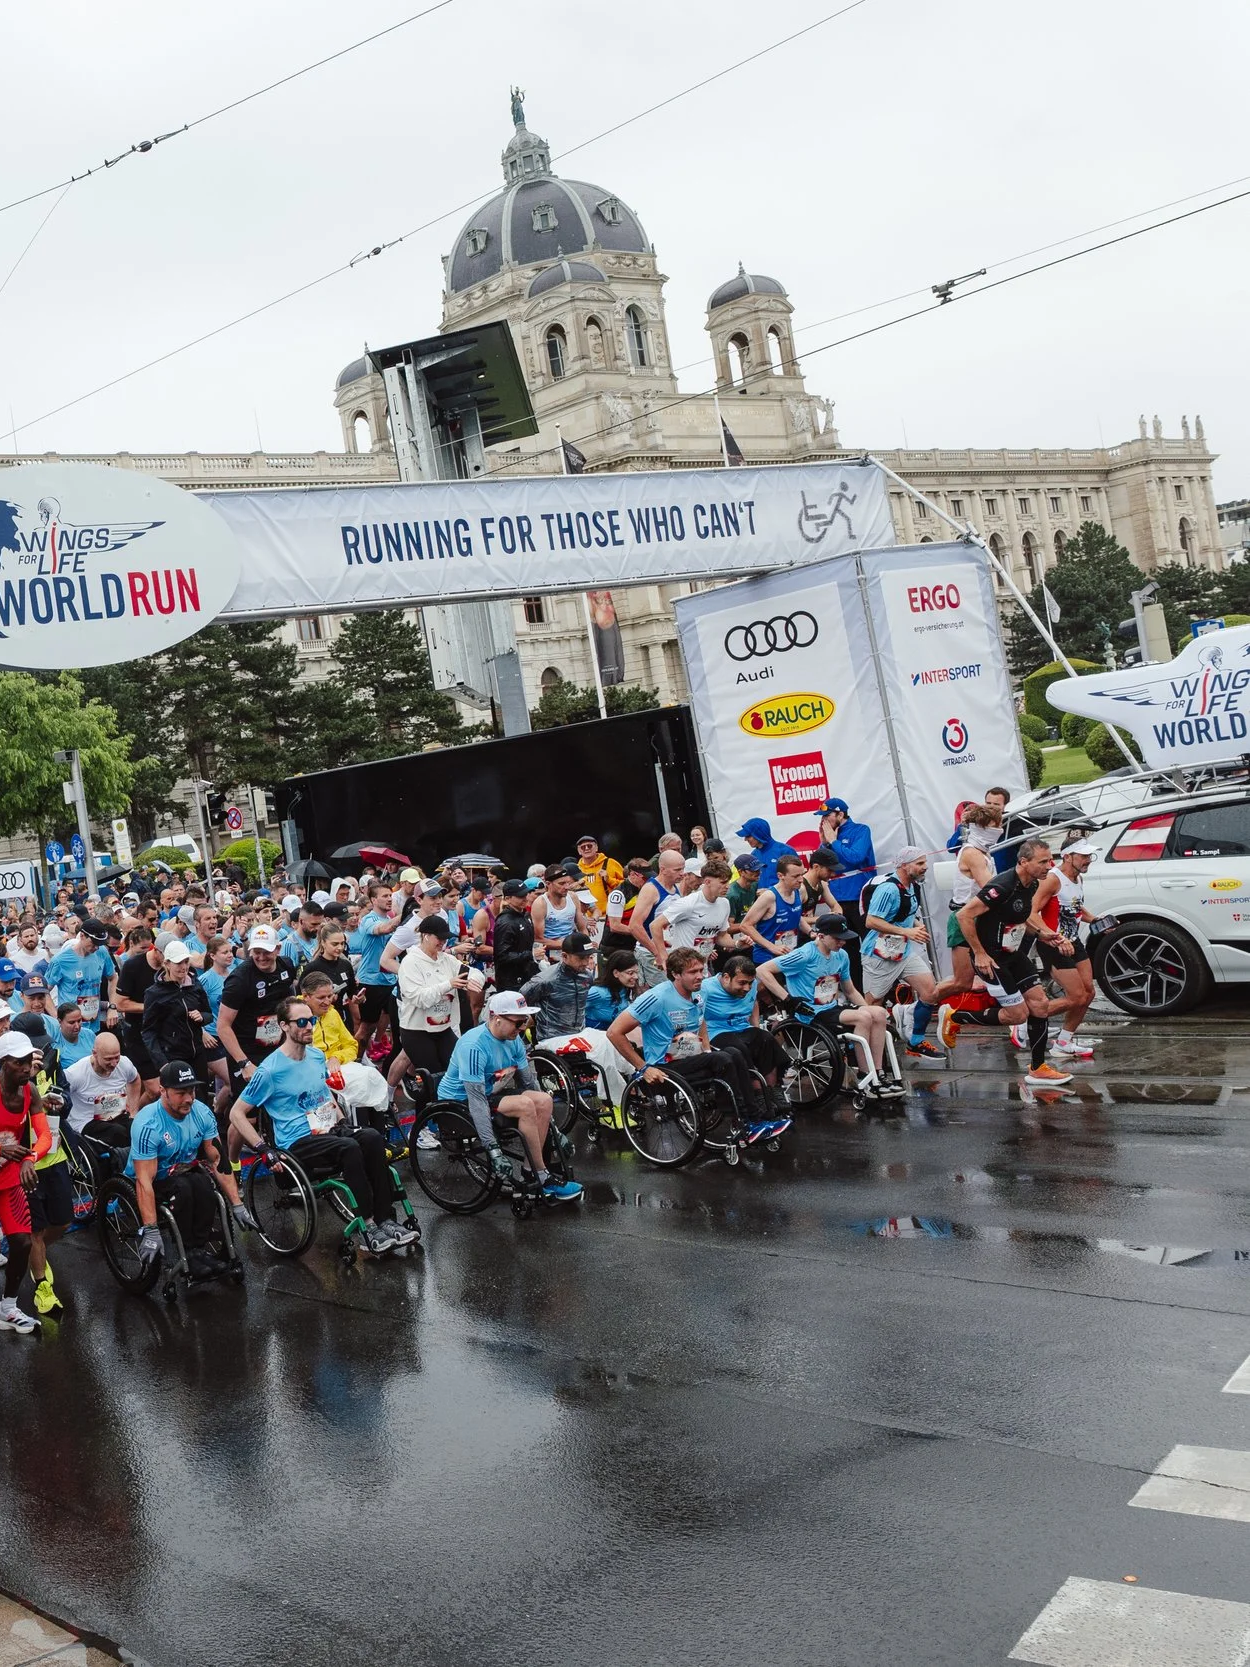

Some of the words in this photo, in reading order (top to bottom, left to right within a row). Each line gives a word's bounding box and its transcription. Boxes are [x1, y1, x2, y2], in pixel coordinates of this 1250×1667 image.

[341, 518, 473, 565] RUNNING
[481, 515, 537, 556] FOR
[541, 508, 625, 551] THOSE
[628, 505, 685, 545] WHO
[693, 501, 756, 540] CAN'T
[18, 554, 37, 566] FOR
[127, 568, 201, 617] RUN
[907, 583, 961, 613] ERGO
[914, 620, 965, 635] ergo-versicherung.at
[735, 665, 775, 685] Audi
[921, 664, 982, 685] INTERSPORT
[764, 700, 825, 728] RAUCH
[1165, 700, 1186, 711] FOR
[1153, 712, 1248, 750] WORLD
[942, 756, 968, 767] HITRADIO
[772, 761, 824, 784] Kronen
[776, 782, 827, 804] Zeitung
[1200, 848, 1220, 856] Sampl
